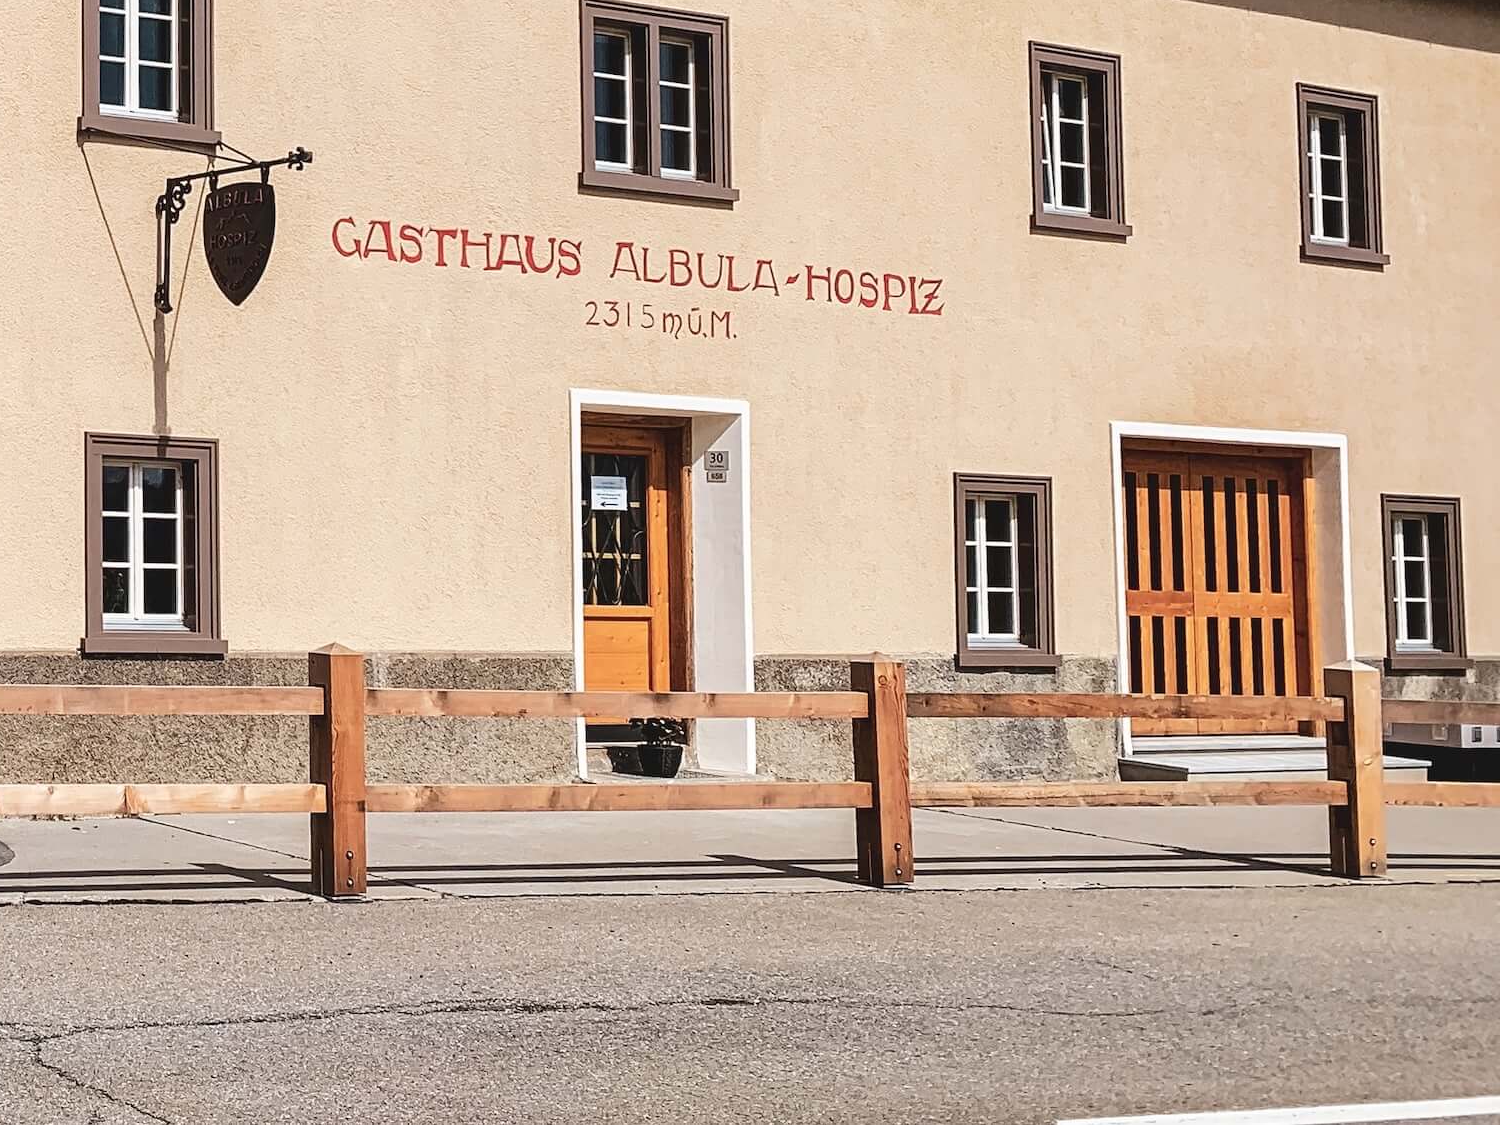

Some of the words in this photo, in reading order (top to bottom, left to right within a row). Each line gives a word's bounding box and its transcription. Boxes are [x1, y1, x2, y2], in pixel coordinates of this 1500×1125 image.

[332, 217, 583, 279] GASTHAUS
[610, 242, 946, 316] ALBULA-HOSPIZ
[585, 301, 655, 329] 2315
[709, 452, 723, 464] 30
